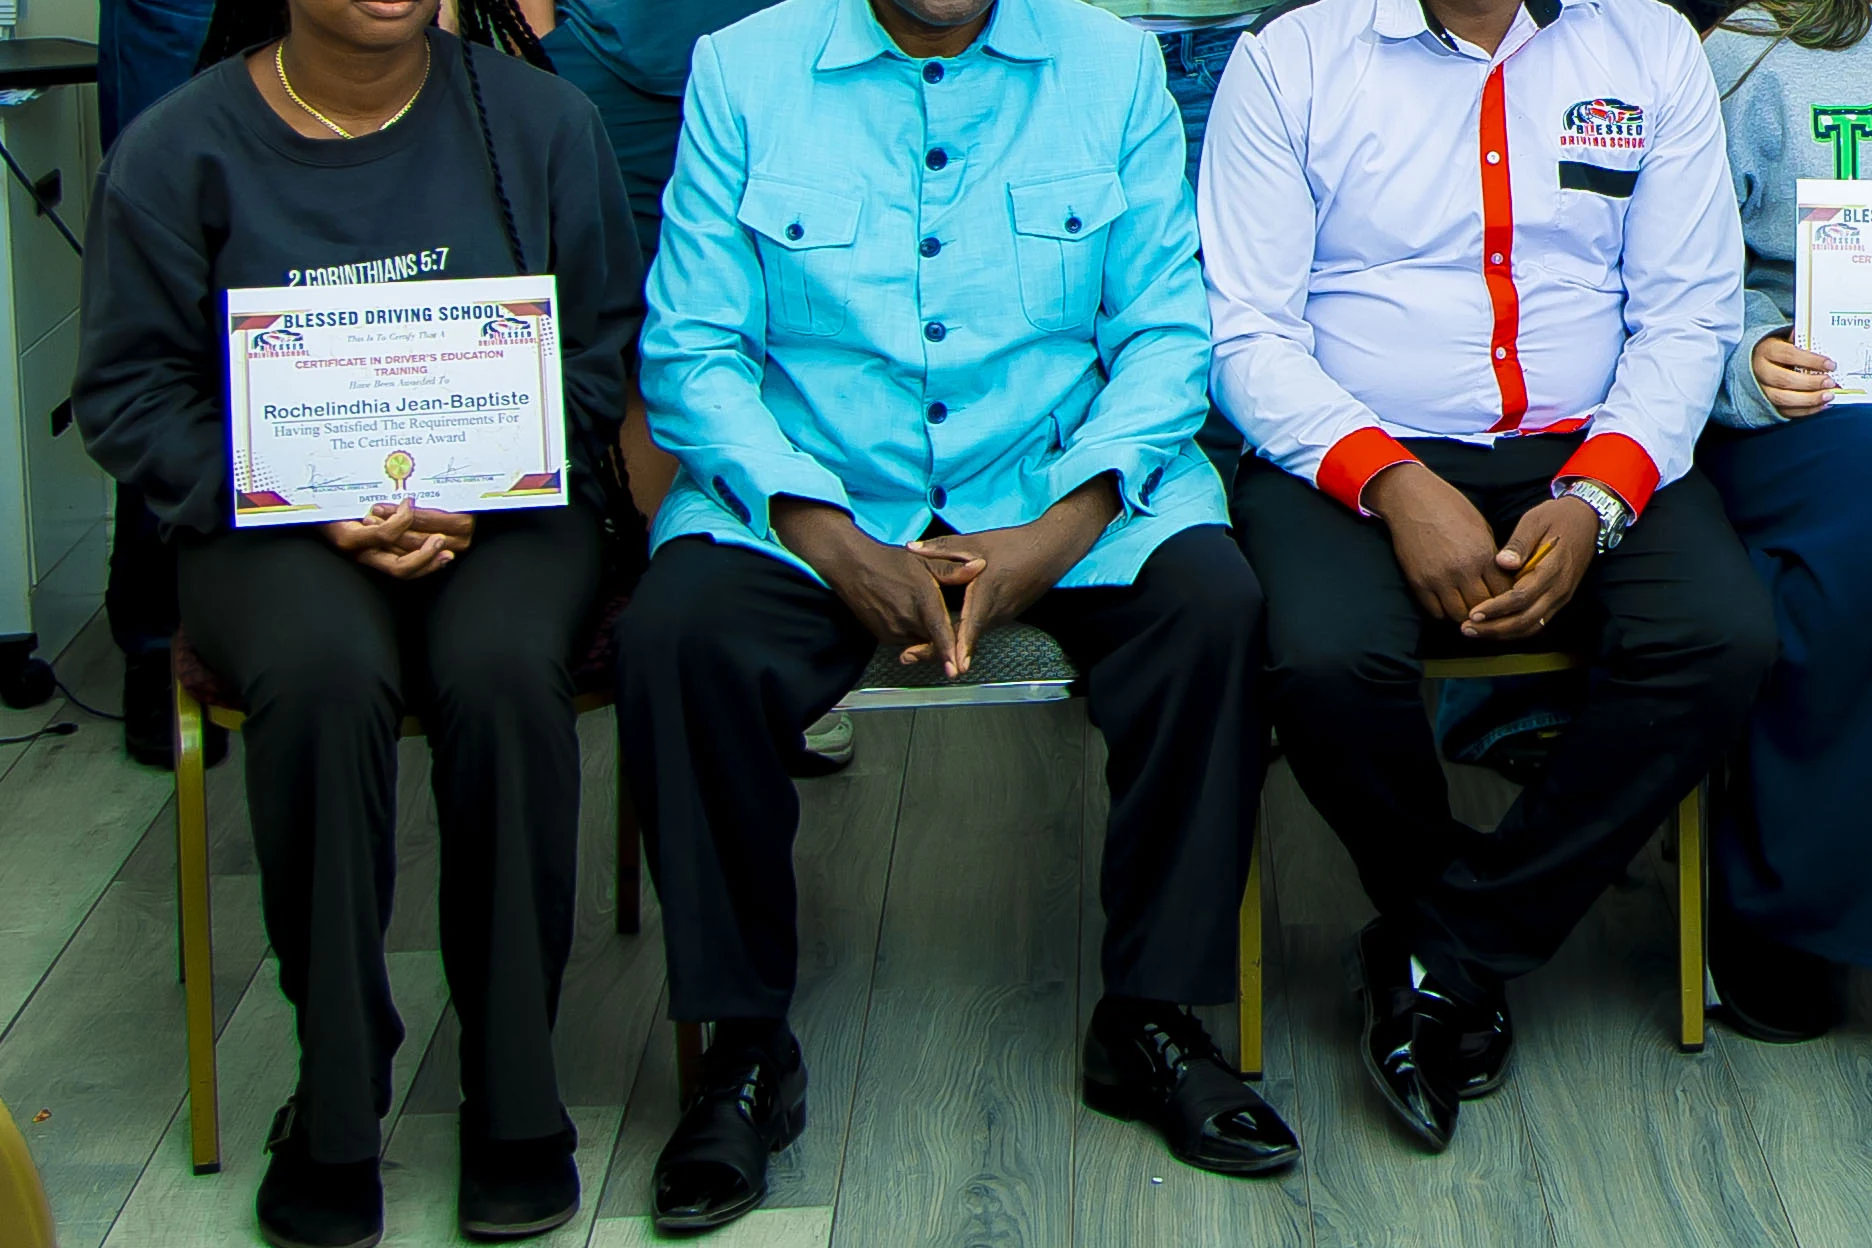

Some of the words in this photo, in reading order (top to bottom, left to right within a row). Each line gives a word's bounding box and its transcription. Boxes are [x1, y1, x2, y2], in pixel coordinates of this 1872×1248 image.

[1560, 136, 1607, 147] DRIVING
[305, 253, 417, 286] CORINTHIANS
[420, 247, 449, 271] 5:7
[283, 311, 358, 329] BLESSED
[365, 307, 433, 325] DRIVING
[440, 304, 505, 321] SCHOOL
[1831, 316, 1871, 328] Having
[295, 357, 367, 370] CERTIFICATE
[370, 355, 382, 365] IN
[385, 354, 437, 365] DRIVER'S
[441, 350, 504, 361] EDUCATION
[374, 365, 428, 376] TRAINING
[264, 400, 391, 421] Rochelindhia
[396, 392, 529, 413] Jean-Baptiste
[274, 423, 321, 439] Having
[324, 419, 379, 435] Satisfied
[382, 418, 406, 431] The
[409, 414, 494, 432] Requirements
[498, 412, 520, 424] For
[330, 438, 355, 450] The
[358, 434, 423, 449] Certificate
[426, 431, 466, 445] Award
